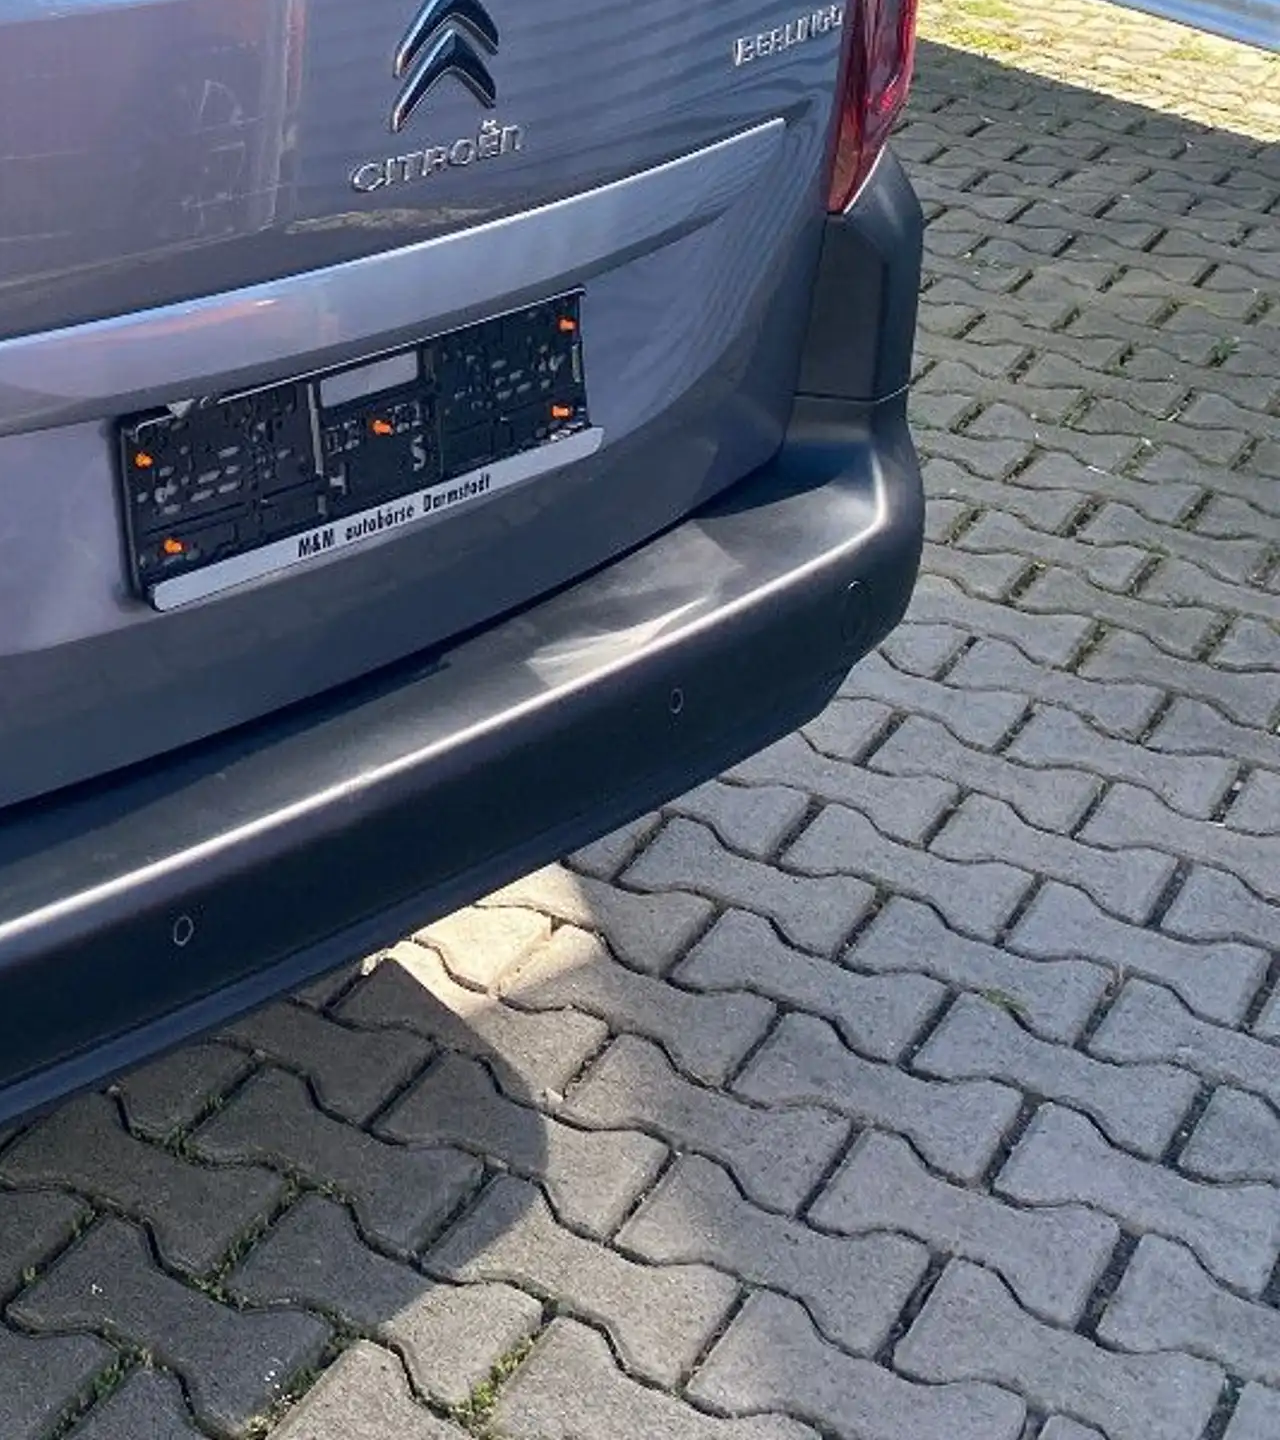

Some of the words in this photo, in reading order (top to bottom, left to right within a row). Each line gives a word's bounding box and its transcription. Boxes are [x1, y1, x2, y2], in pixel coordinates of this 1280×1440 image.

[297, 527, 336, 558] M&M
[344, 506, 416, 542] autobörse
[422, 471, 492, 514] Darmstadt
